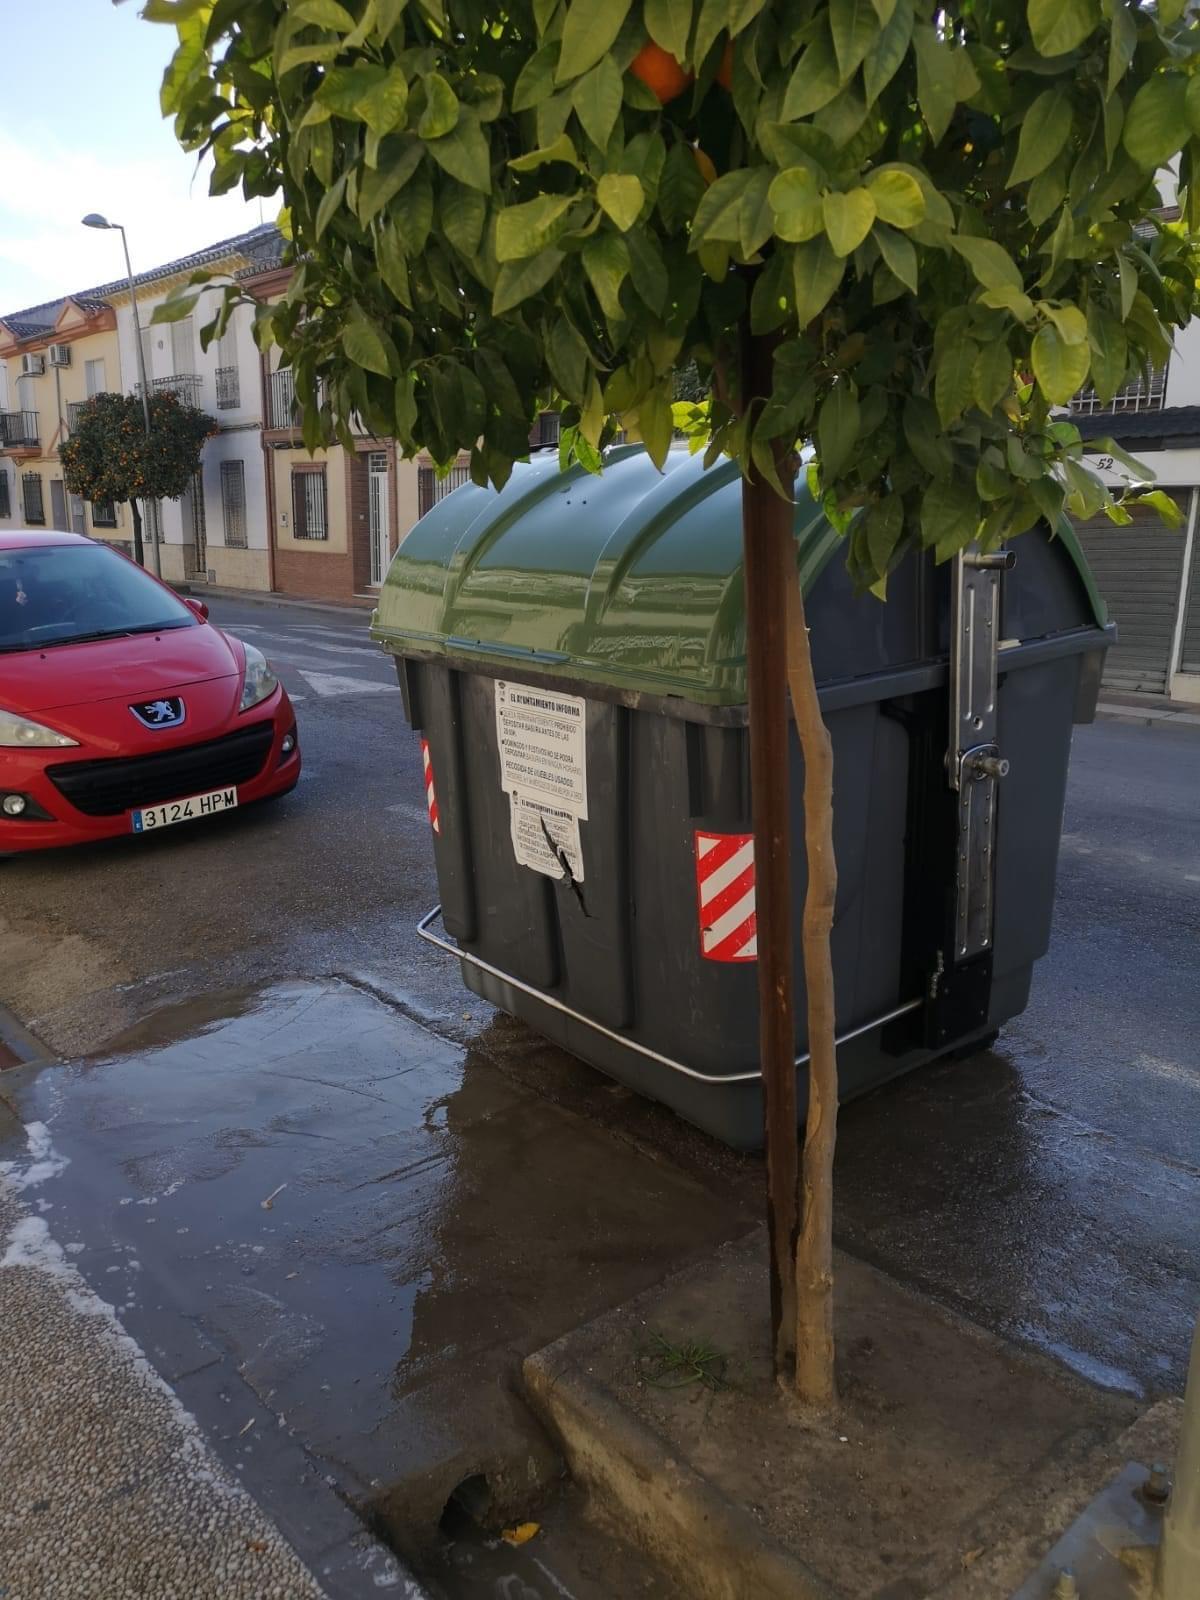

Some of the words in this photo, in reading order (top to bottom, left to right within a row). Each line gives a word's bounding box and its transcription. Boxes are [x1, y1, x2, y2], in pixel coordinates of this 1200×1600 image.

[1096, 457, 1113, 470] 52
[511, 694, 516, 703] EL
[517, 695, 555, 711] AYUNTAMIENTO
[556, 701, 580, 716] INFORMA
[503, 718, 524, 728] DEPOSITAR
[554, 720, 577, 734] PROHIBIDO
[504, 738, 525, 750] DOMINGOS
[504, 747, 526, 758] DEPOSITAR
[506, 760, 527, 772] RECOGIDA
[527, 766, 533, 776] DE
[534, 769, 554, 781] MUEBLES
[145, 801, 193, 827] 3124
[200, 790, 234, 814] HPM
